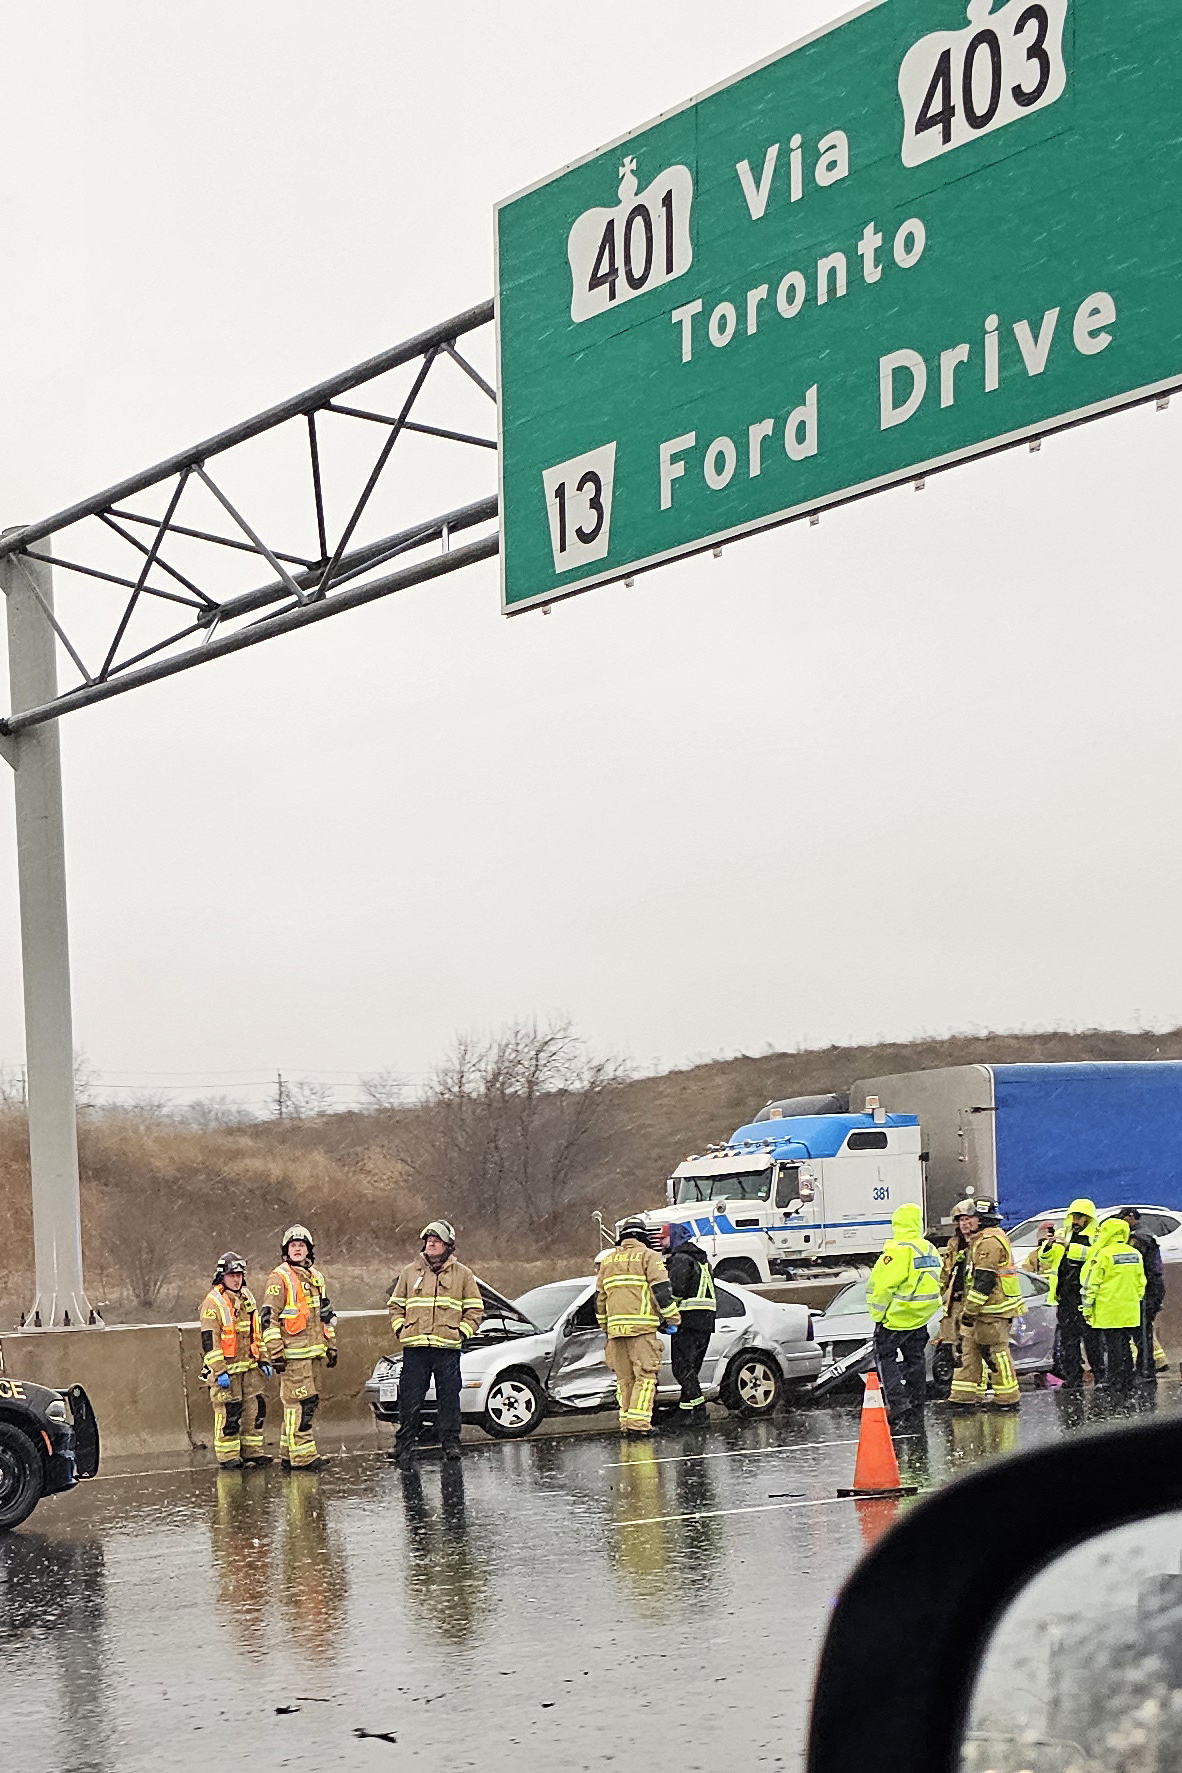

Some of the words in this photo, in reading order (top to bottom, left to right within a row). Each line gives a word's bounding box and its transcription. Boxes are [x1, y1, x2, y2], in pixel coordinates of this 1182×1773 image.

[588, 190, 674, 302] 401
[736, 130, 849, 221] Via
[914, 4, 1051, 146] 403
[672, 217, 926, 363] Toronto
[553, 470, 604, 553] 13
[659, 383, 818, 510] Ford
[880, 291, 1117, 430] Drive
[873, 1187, 890, 1200] 381
